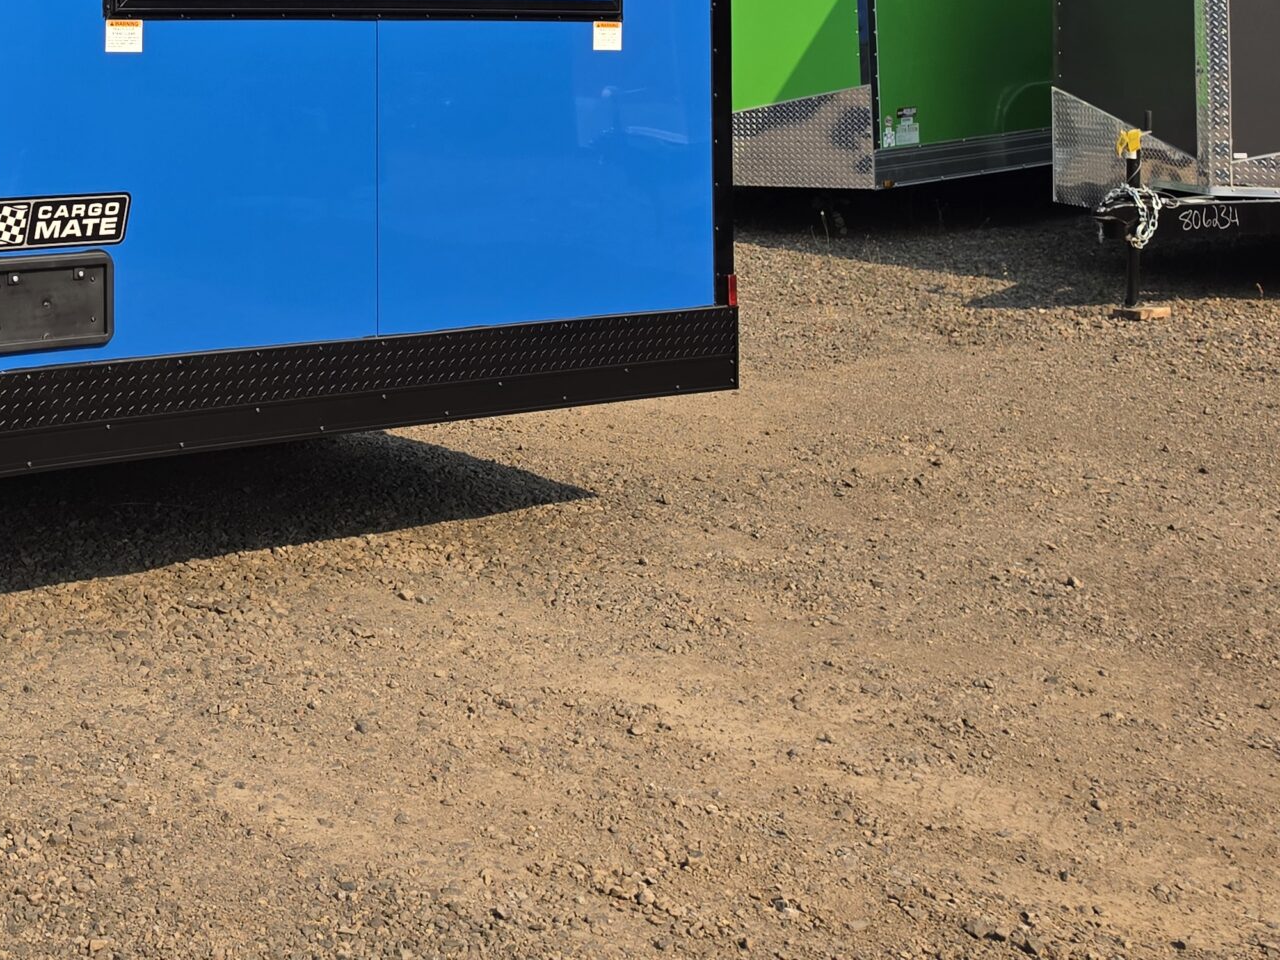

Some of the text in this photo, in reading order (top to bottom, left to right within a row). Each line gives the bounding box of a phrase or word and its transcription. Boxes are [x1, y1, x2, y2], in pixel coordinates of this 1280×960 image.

[37, 201, 120, 220] CARGO
[1178, 204, 1240, 231] 806234
[33, 216, 118, 240] MATE
